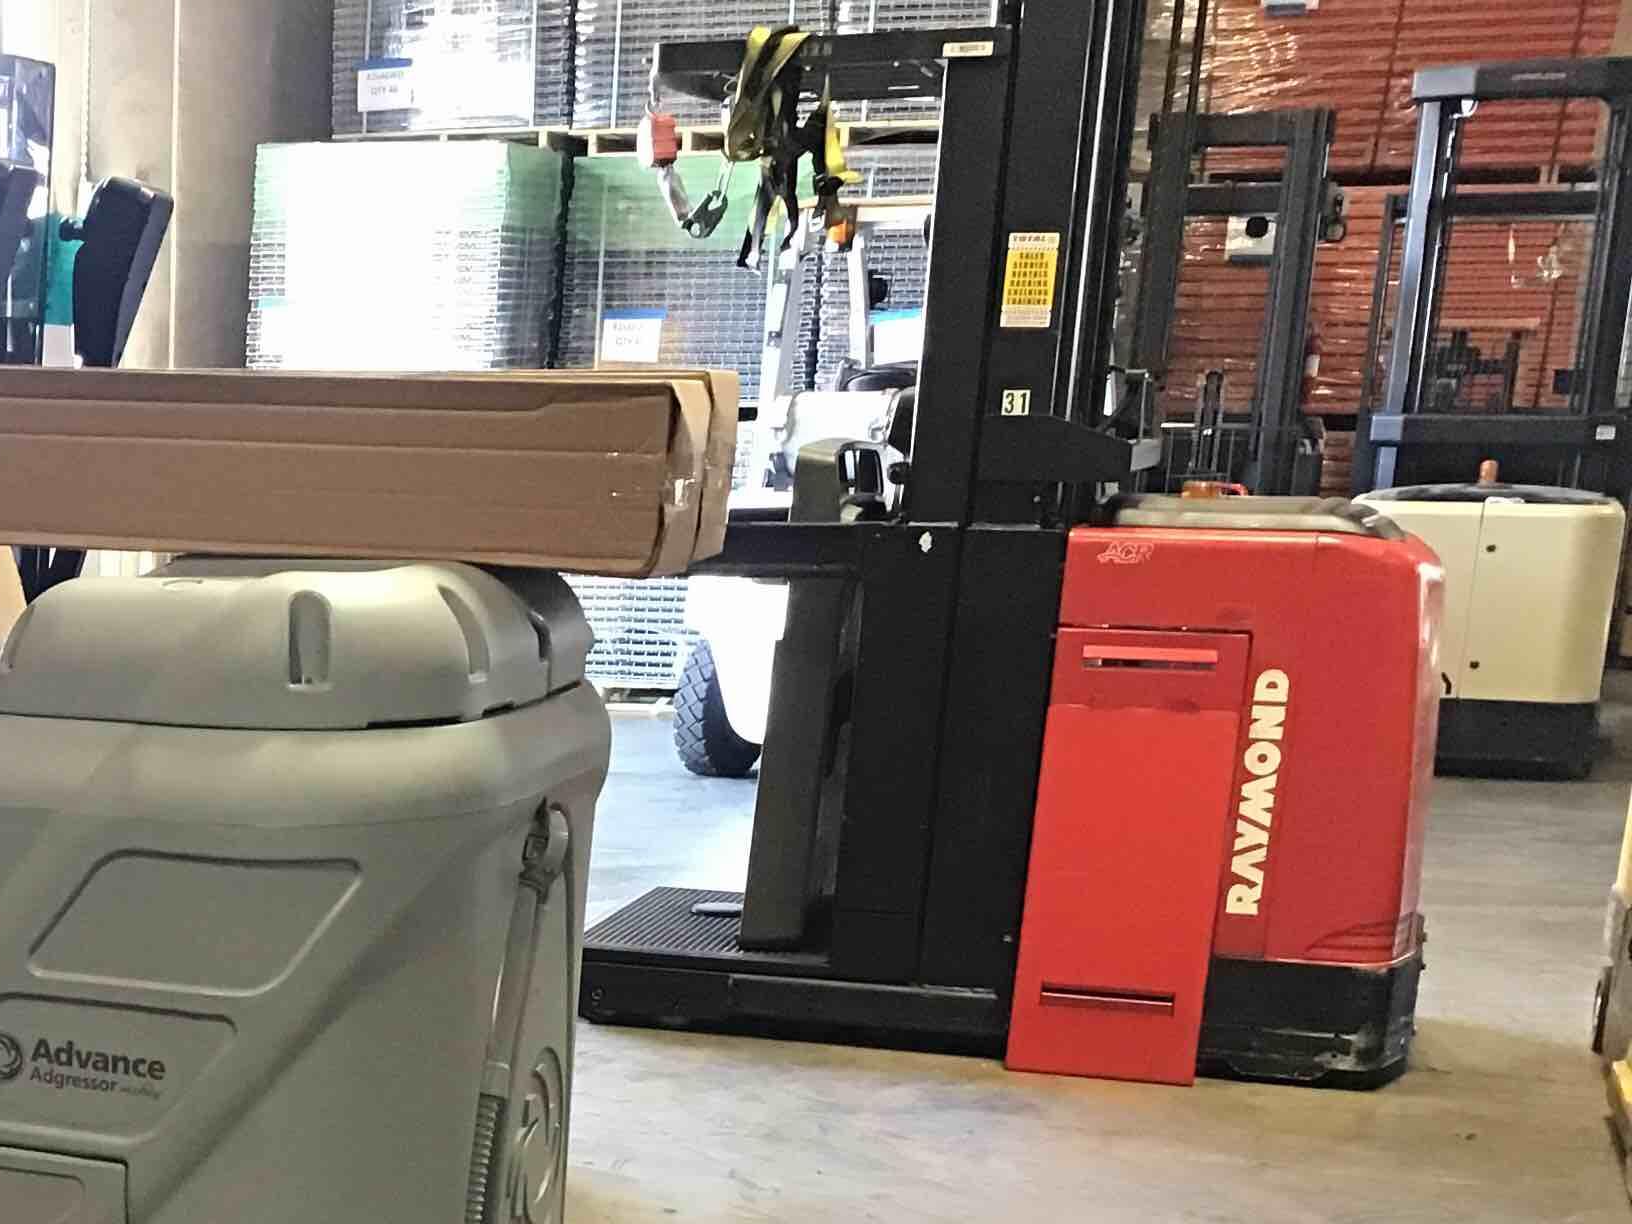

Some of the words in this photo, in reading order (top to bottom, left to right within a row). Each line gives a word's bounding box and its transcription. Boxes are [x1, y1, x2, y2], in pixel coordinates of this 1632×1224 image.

[1225, 668, 1290, 916] RAYMOND
[29, 1066, 119, 1091] Adgressor
[30, 1038, 166, 1081] Advance
